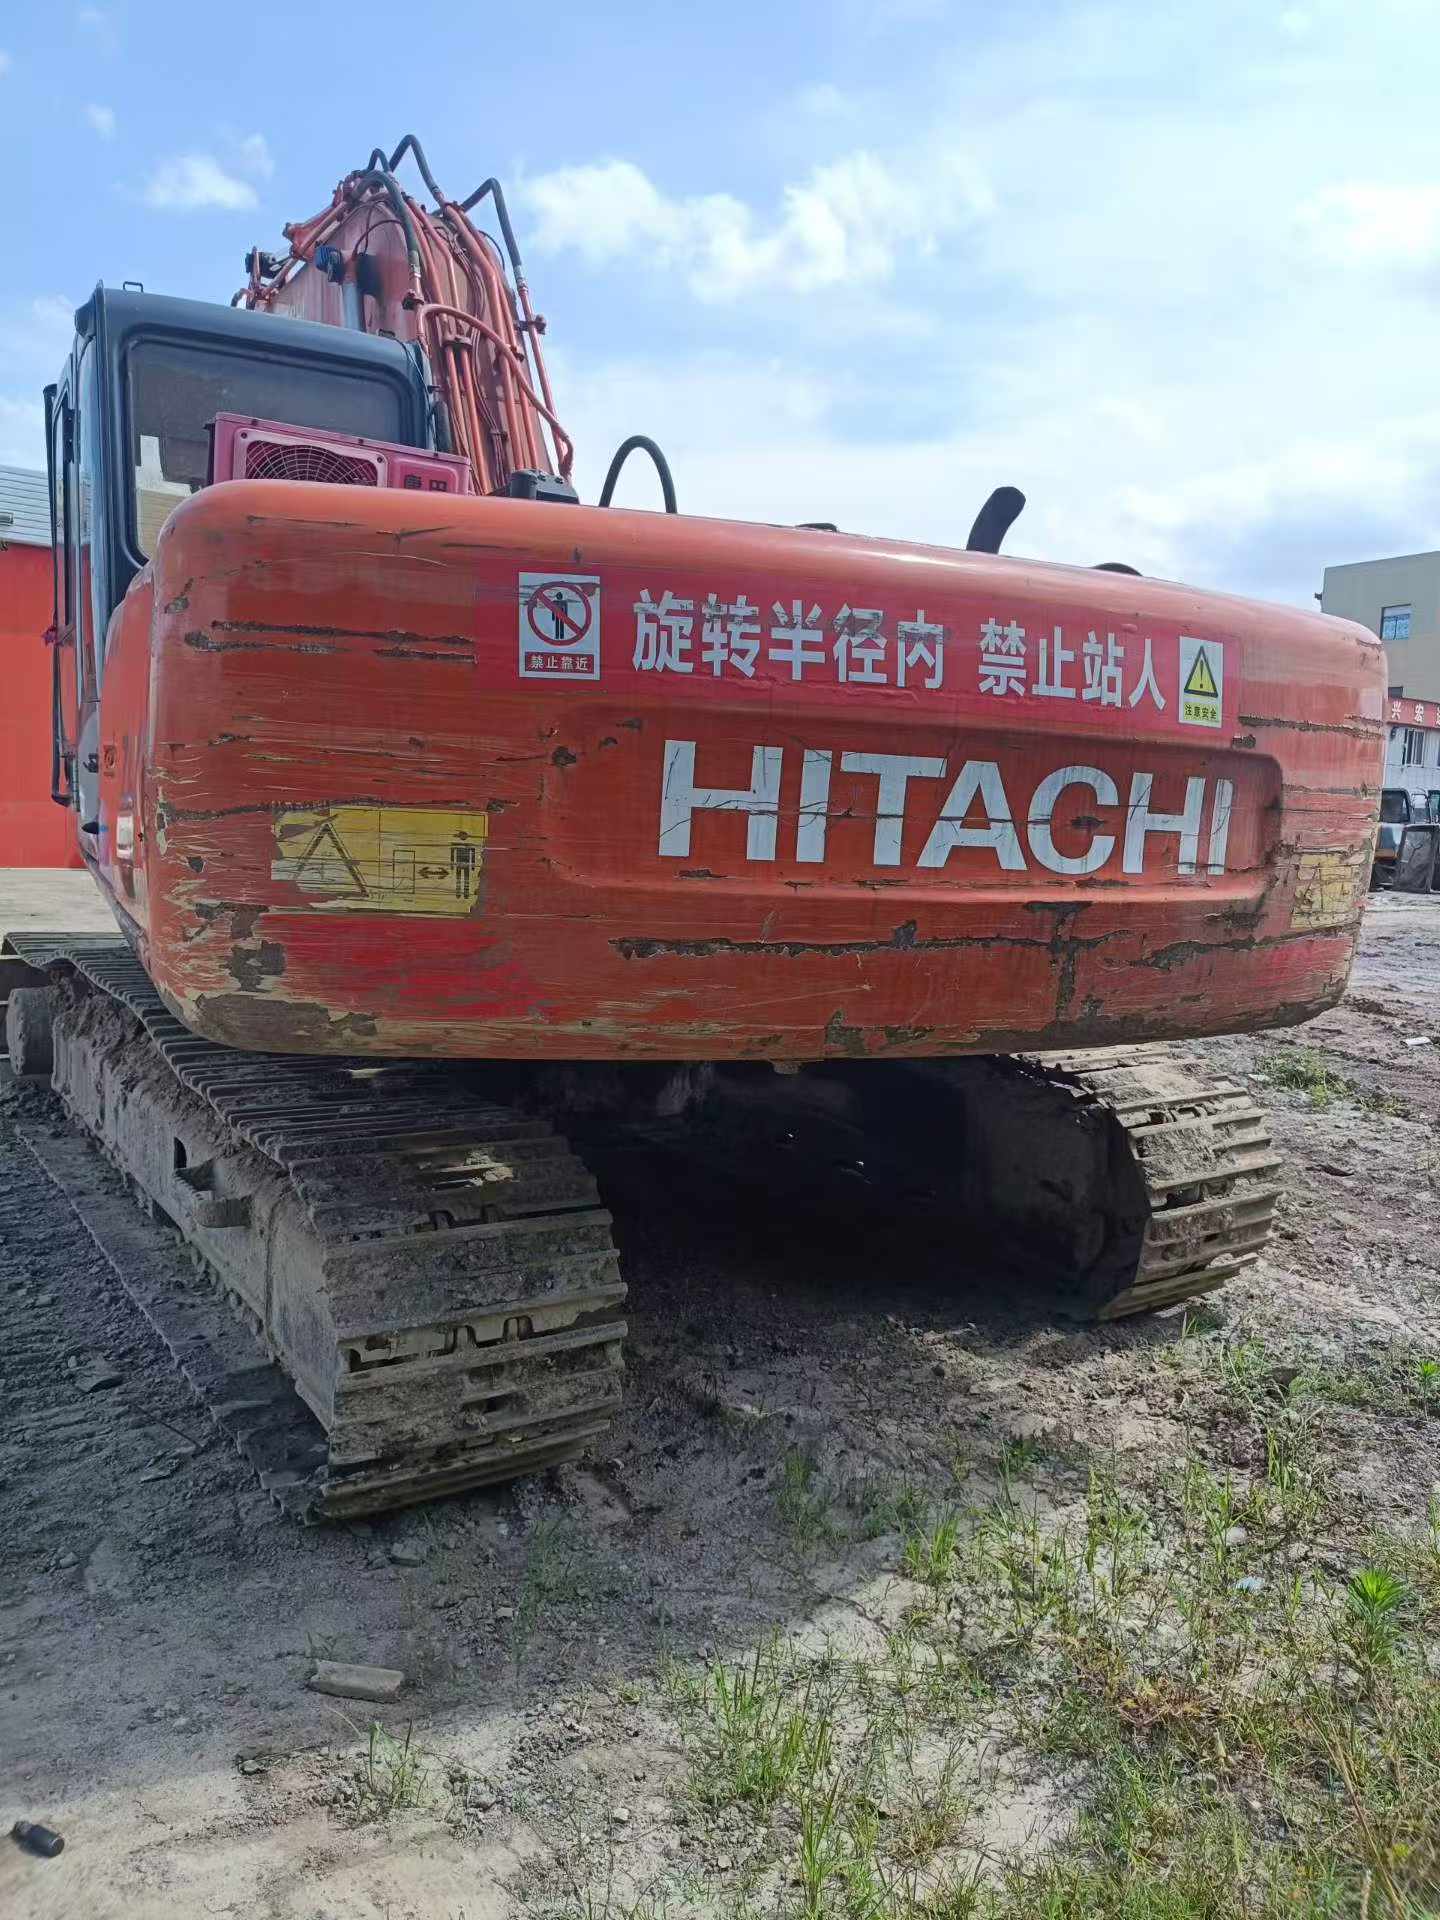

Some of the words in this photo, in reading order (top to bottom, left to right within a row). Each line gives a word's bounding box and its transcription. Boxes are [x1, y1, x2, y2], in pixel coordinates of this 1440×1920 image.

[530, 654, 588, 671] 禁止靠近
[633, 588, 944, 689] 旋转半径内
[978, 617, 1167, 711] 禁止站人
[658, 739, 1234, 877] HITACHI
